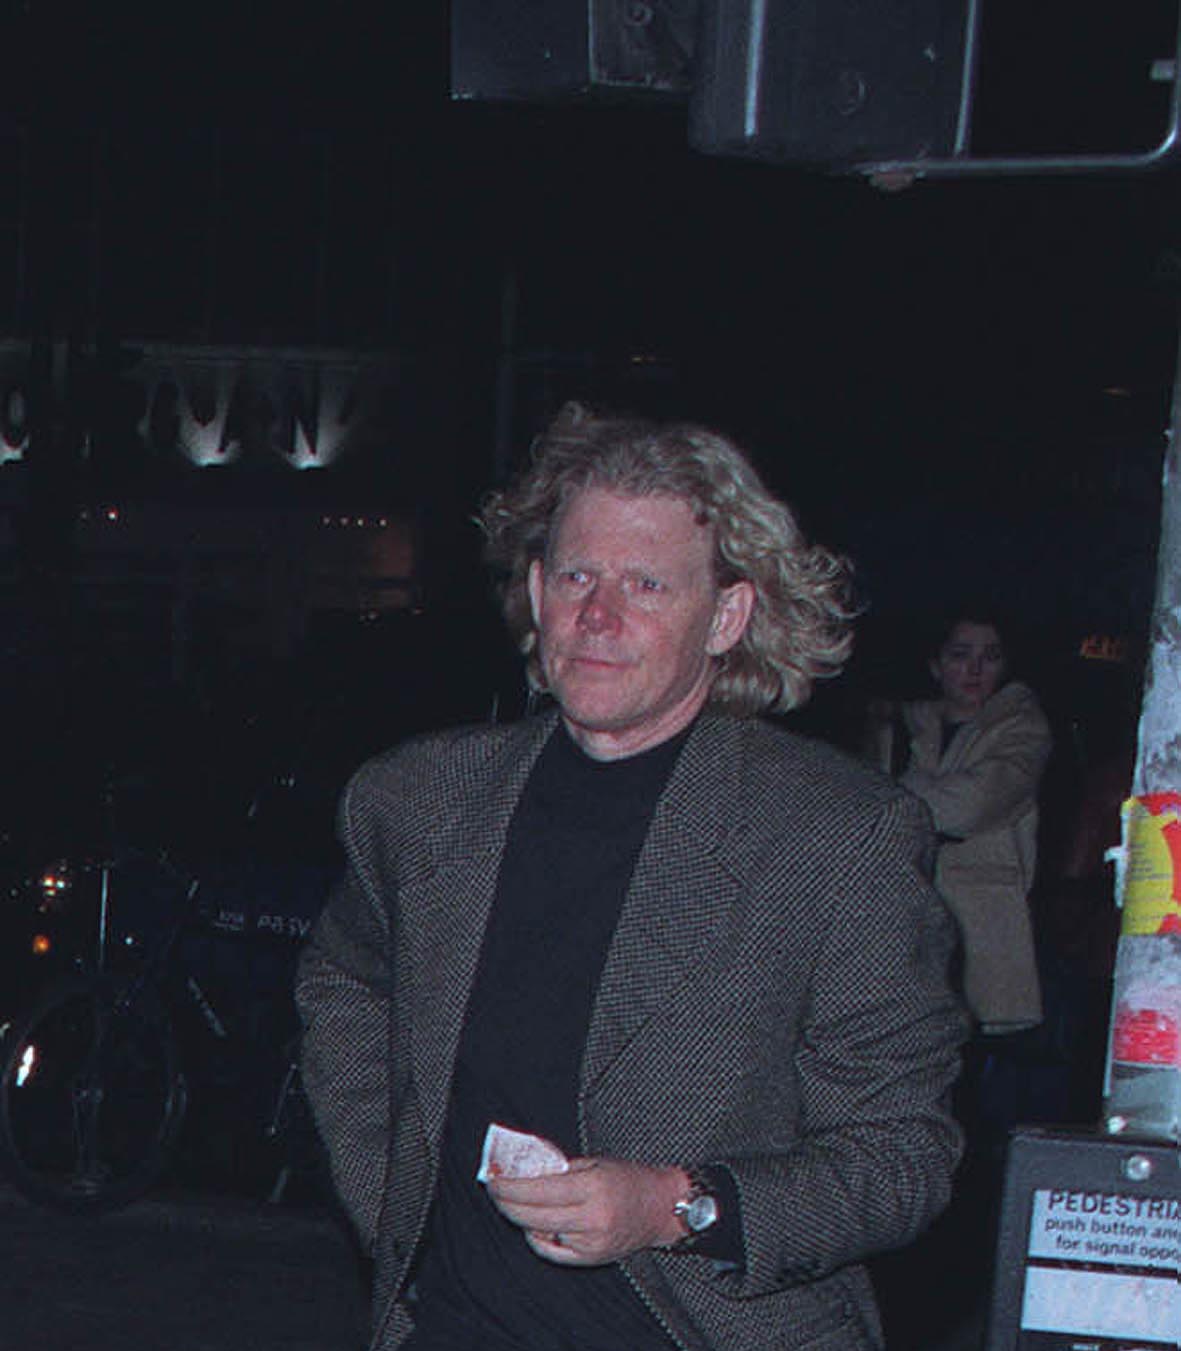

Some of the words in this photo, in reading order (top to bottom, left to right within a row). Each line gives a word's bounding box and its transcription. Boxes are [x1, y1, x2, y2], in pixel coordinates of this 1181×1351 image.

[1045, 1216, 1086, 1233] push
[1090, 1218, 1147, 1237] button
[1055, 1234, 1080, 1251] for
[1085, 1239, 1136, 1257] signal
